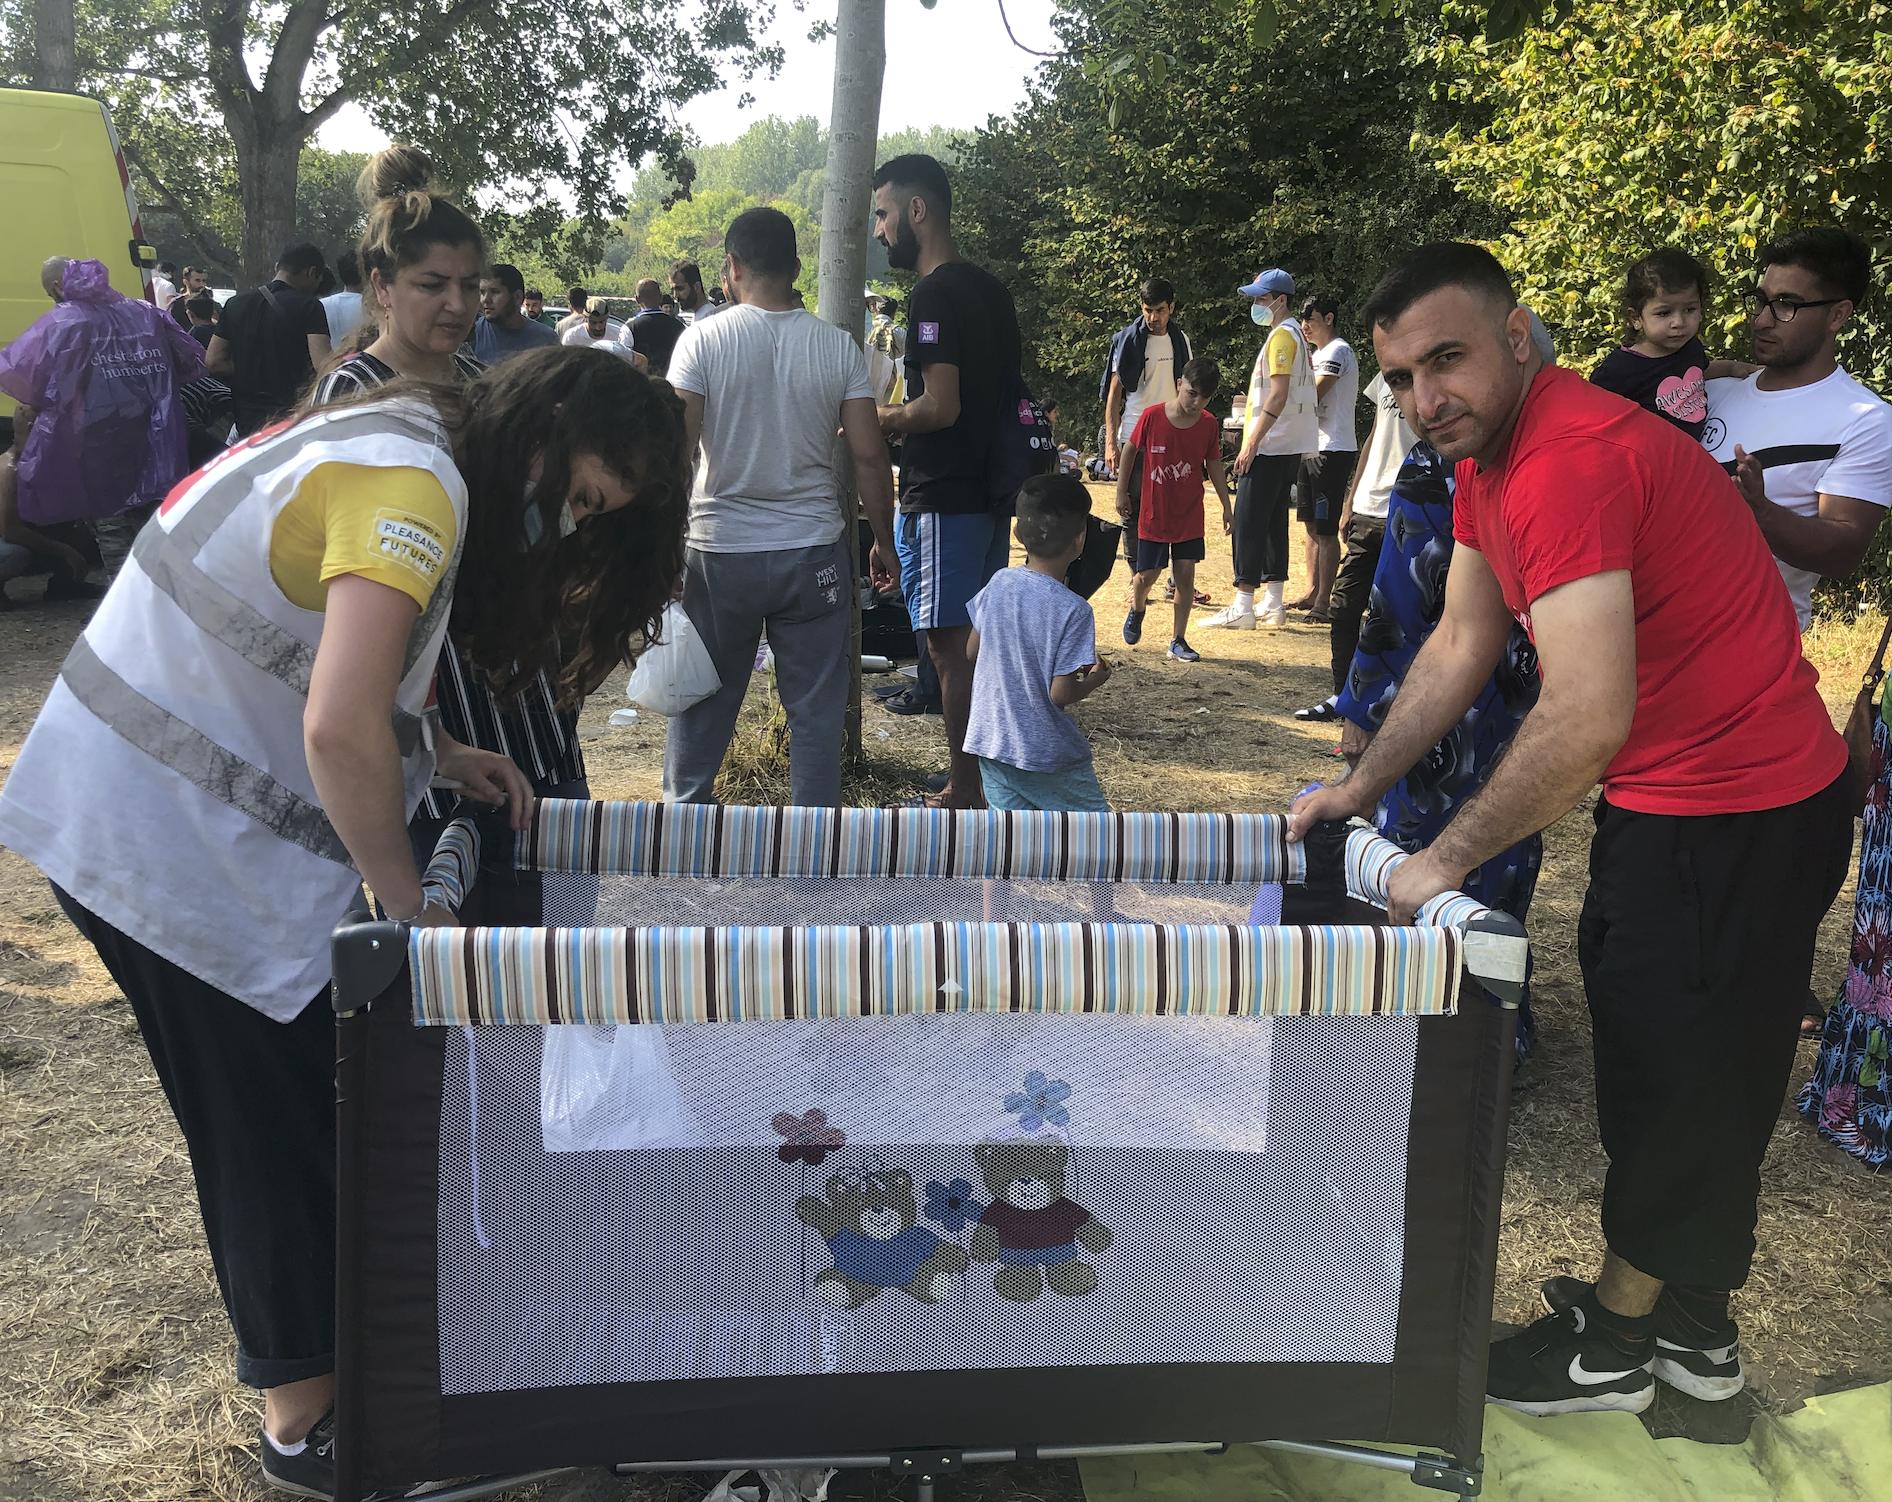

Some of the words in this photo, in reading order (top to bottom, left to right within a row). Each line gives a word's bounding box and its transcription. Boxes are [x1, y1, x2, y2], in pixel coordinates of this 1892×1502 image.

[91, 348, 162, 366] chesterton
[101, 362, 167, 379] humberts
[1655, 379, 1704, 410] AWESOM
[384, 523, 443, 560] PLEASANCE
[380, 537, 438, 573] FUTURES
[815, 564, 837, 578] WEST
[817, 571, 839, 587] HILL
